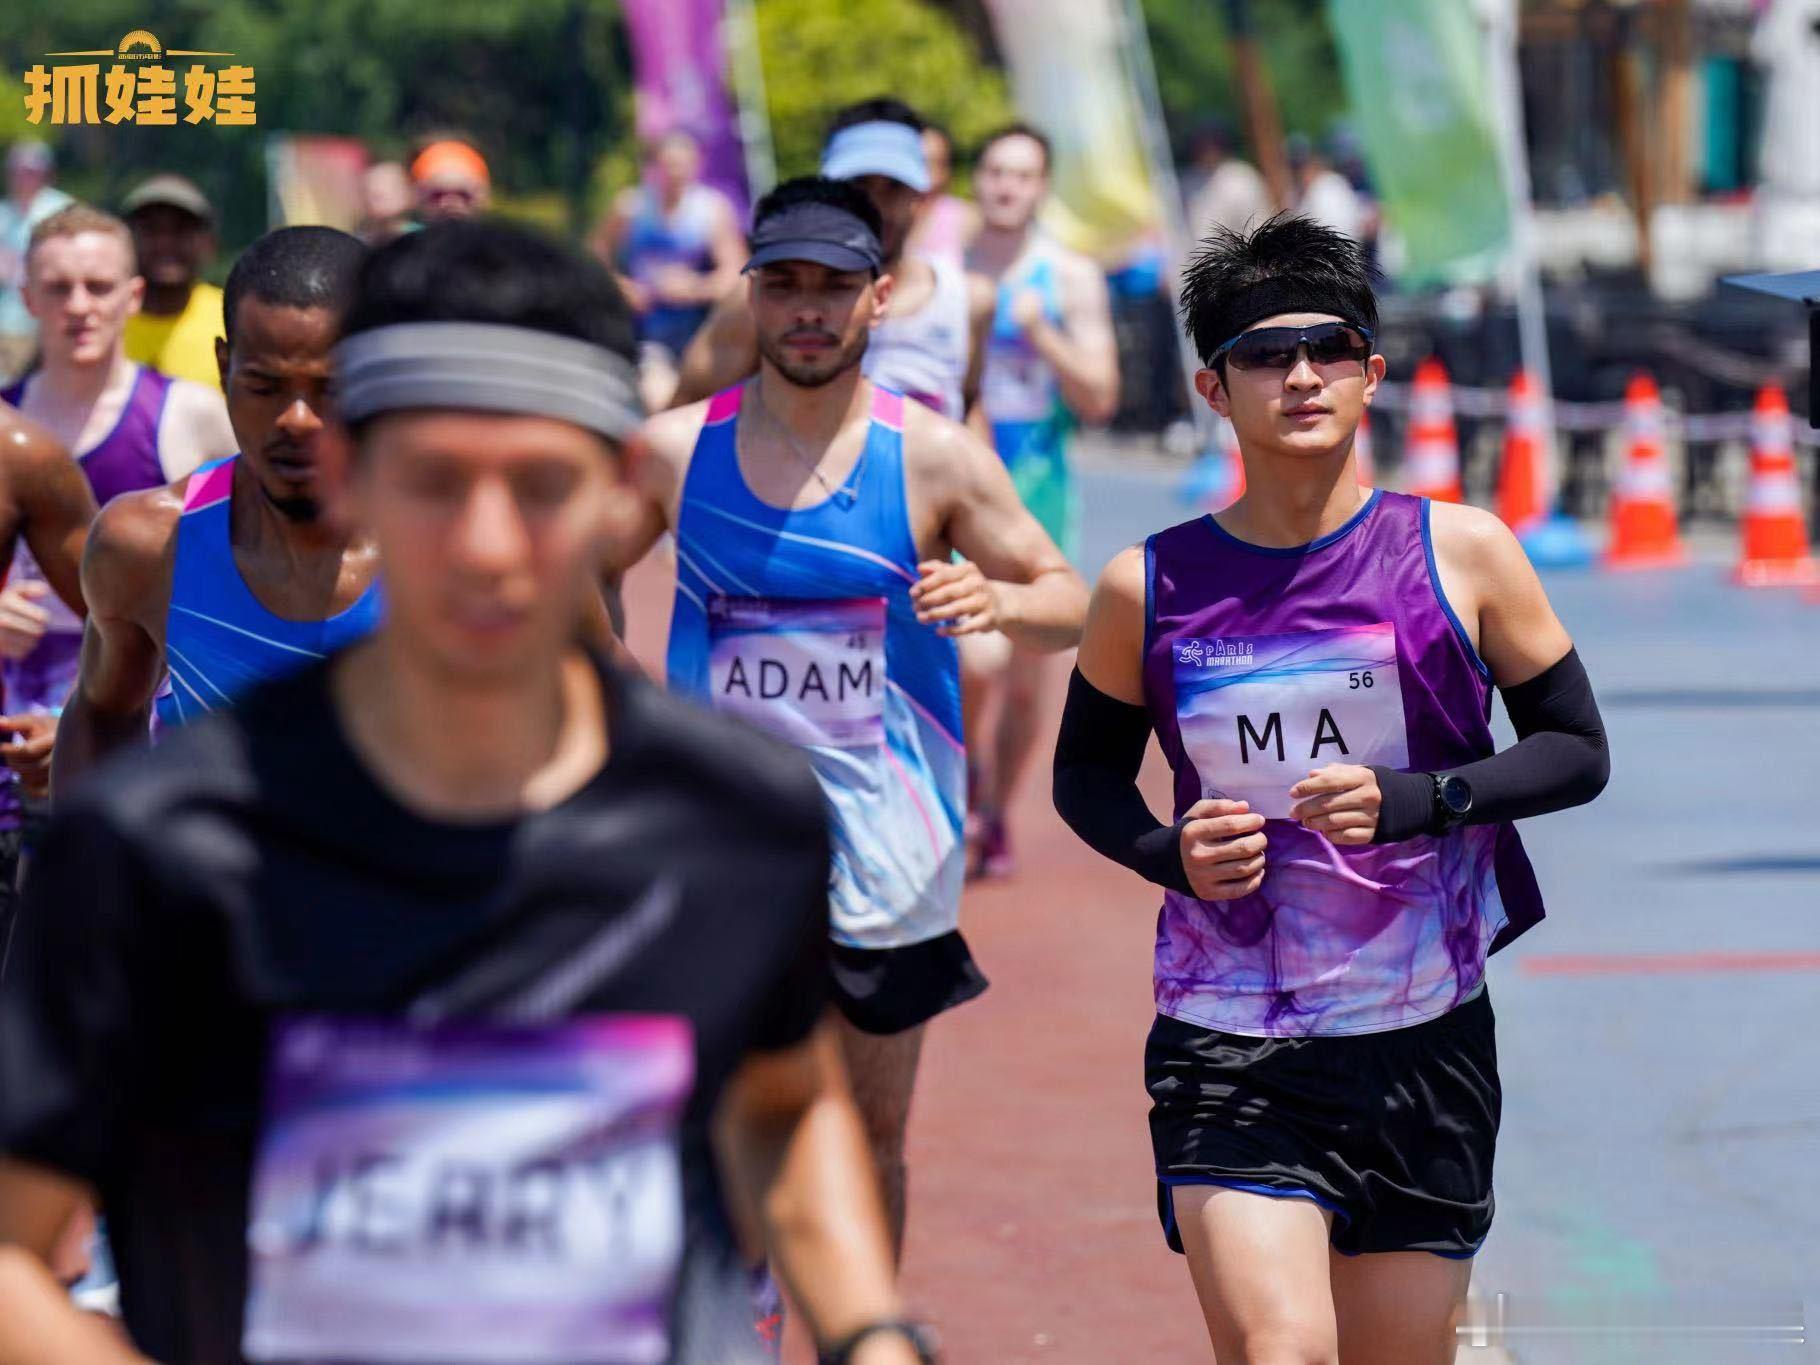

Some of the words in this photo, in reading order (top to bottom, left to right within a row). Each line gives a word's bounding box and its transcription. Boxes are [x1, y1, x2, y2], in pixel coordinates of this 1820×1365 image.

[1206, 655, 1253, 666] MARATHON
[725, 655, 873, 702] ADAM
[1349, 671, 1374, 689] 56
